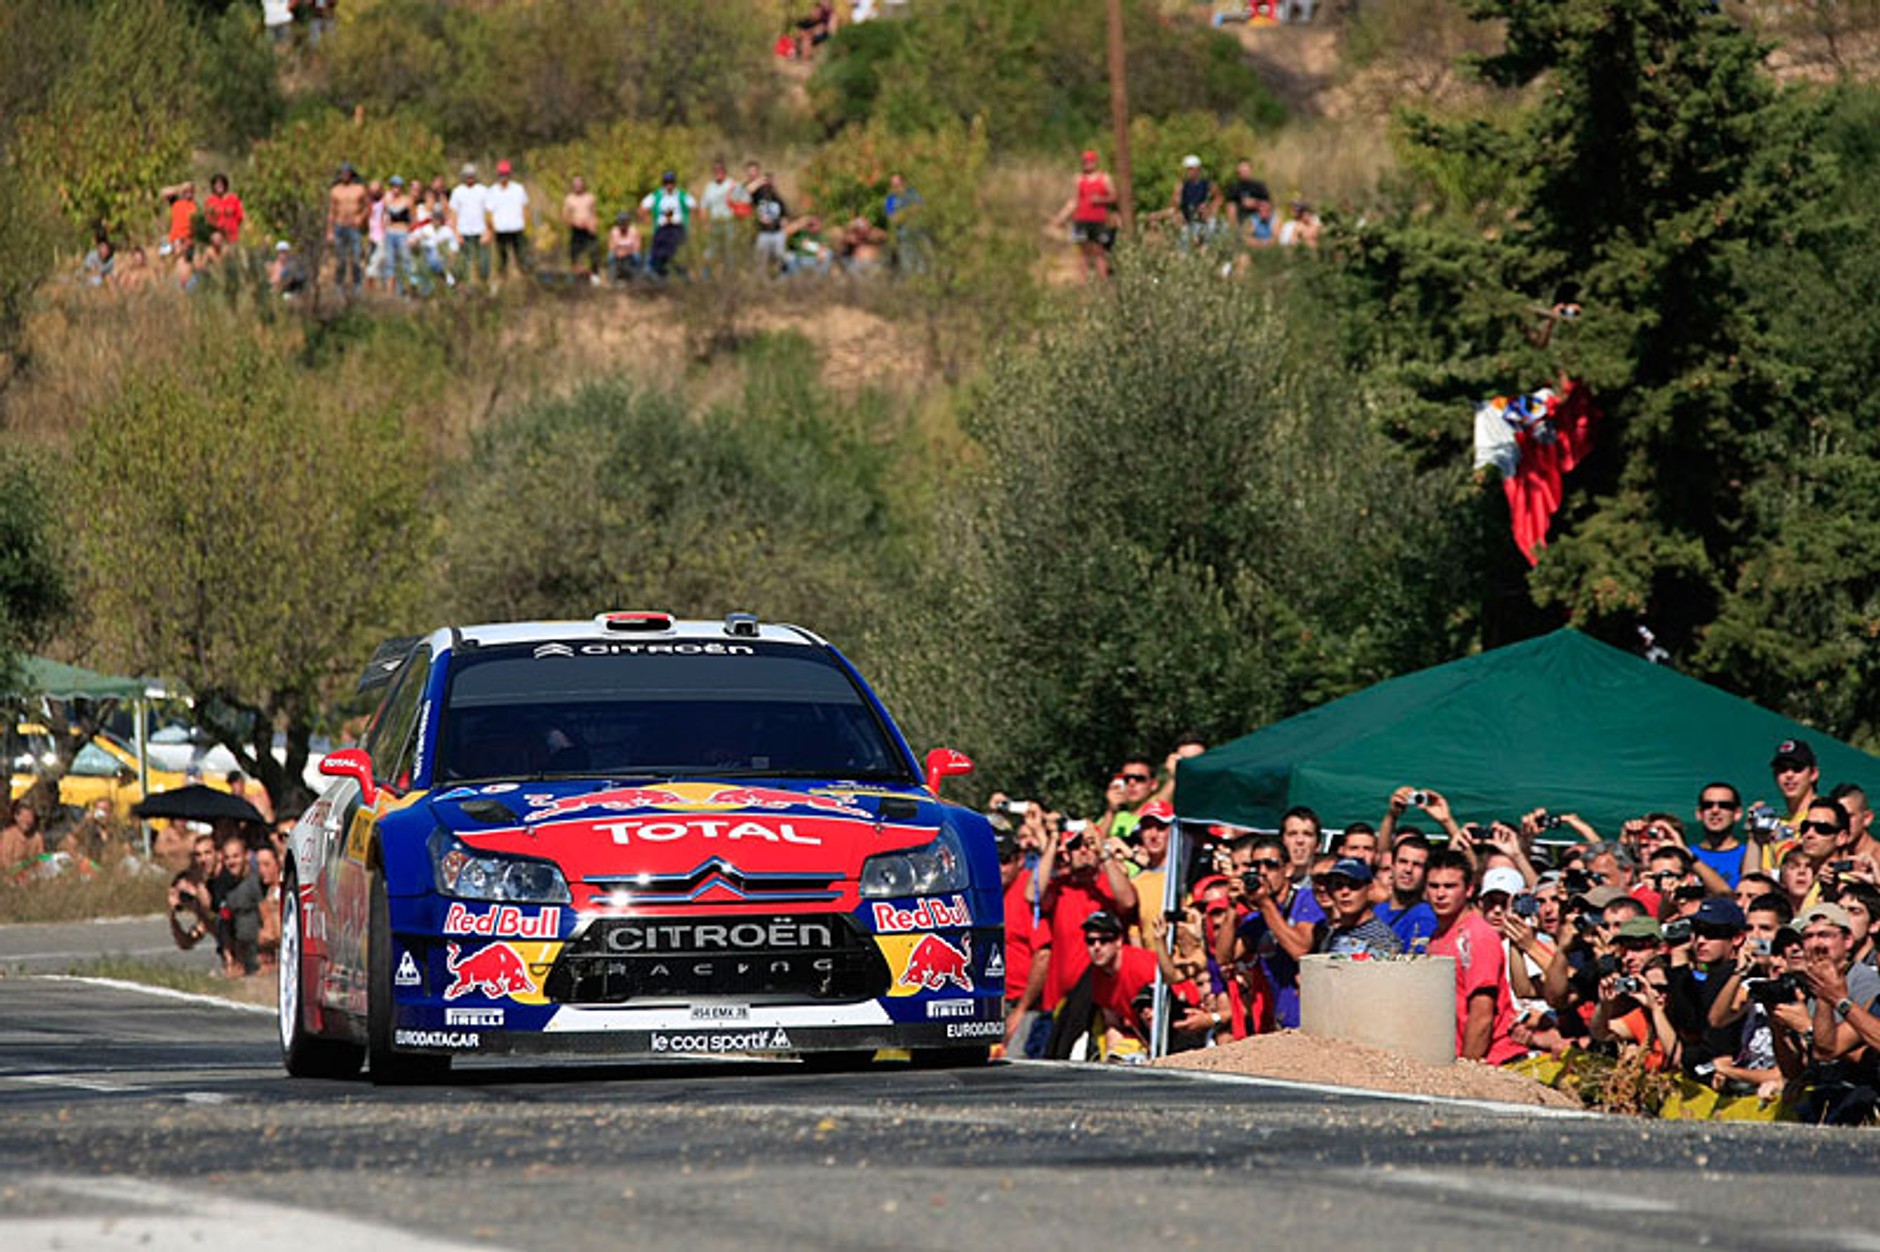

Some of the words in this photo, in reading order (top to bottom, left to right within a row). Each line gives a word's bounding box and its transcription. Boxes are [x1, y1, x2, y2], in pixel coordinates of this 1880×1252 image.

[592, 820, 822, 845] TOTAL
[443, 902, 500, 936] Red
[496, 906, 561, 938] Bull
[872, 898, 934, 933] Red
[928, 895, 973, 927] Bull
[445, 1008, 504, 1025] PIRELLI
[927, 998, 974, 1018] PIRELLI
[395, 1028, 480, 1047] EURODATACAR
[651, 1032, 668, 1051] le
[670, 1035, 708, 1052] coq
[710, 1031, 769, 1053] sportif
